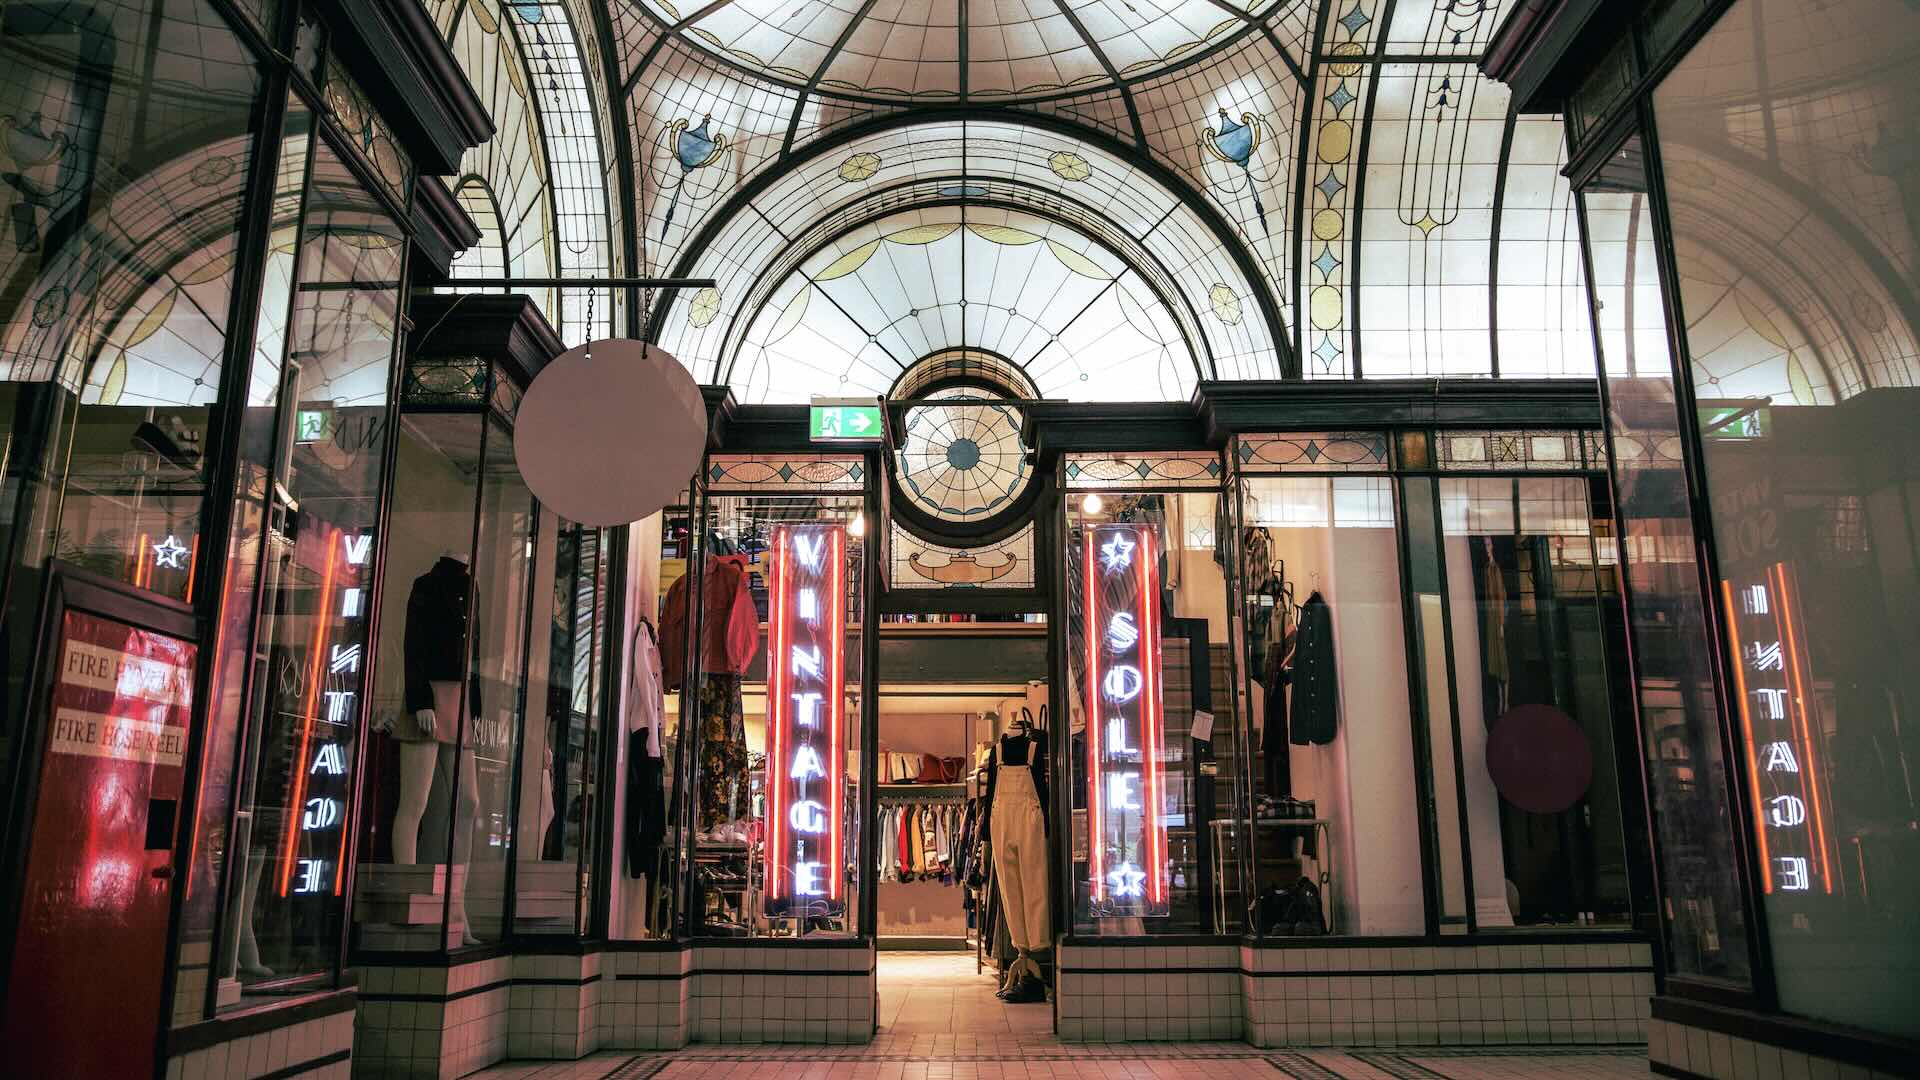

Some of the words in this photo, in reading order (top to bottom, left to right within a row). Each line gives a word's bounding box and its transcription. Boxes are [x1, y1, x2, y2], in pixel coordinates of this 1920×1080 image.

[67, 651, 109, 680] FIRE
[789, 533, 828, 897] VINTAGE
[1103, 611, 1144, 811] SOLE
[56, 718, 97, 744] FIRE
[102, 726, 142, 751] HOSE
[146, 734, 185, 755] REEL
